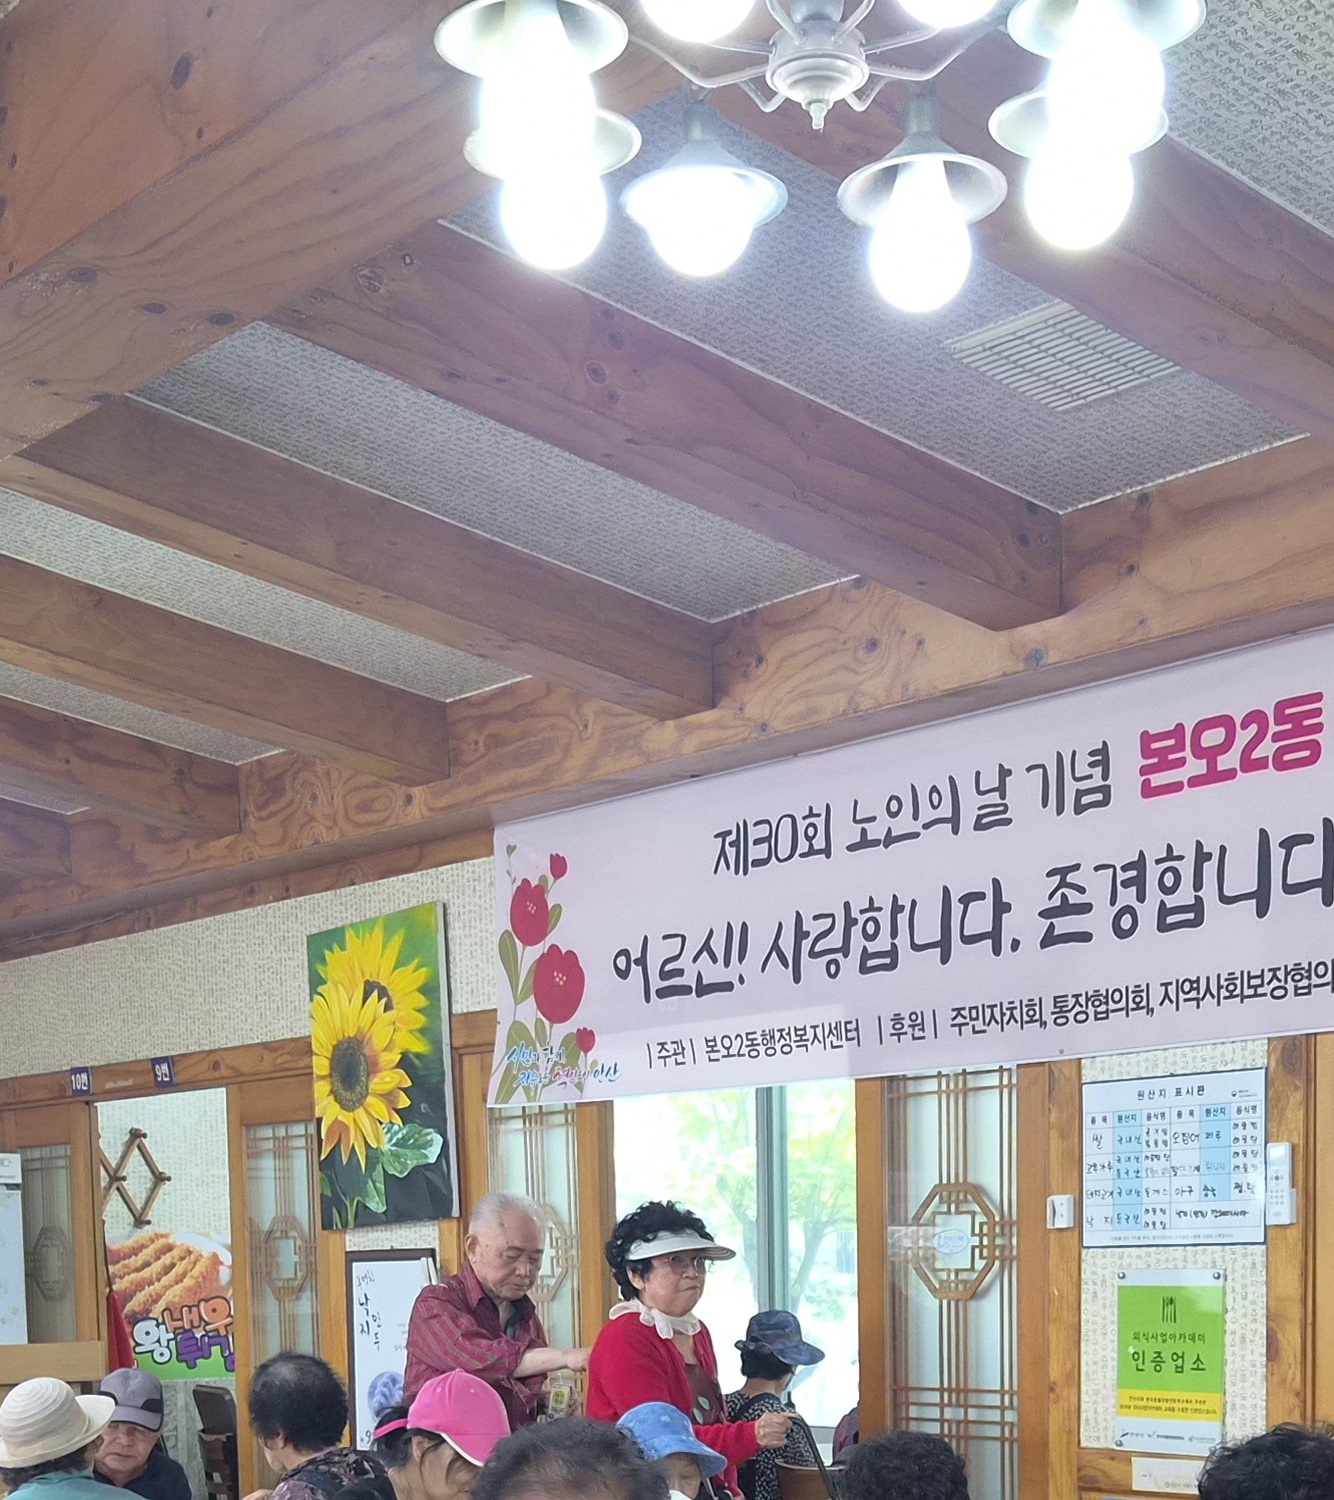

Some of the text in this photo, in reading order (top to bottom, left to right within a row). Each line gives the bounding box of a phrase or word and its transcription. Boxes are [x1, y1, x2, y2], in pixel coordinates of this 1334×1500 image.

[713, 803, 832, 876] 제30회
[846, 775, 961, 854] 노인의
[973, 762, 1013, 831] 날
[1026, 740, 1113, 816] 기념
[1139, 690, 1324, 799] 본오2동
[612, 921, 749, 1004] 어르신!
[761, 878, 1020, 985] 사랑합니다.
[704, 1018, 861, 1062] 본오2동행정복지센터
[950, 996, 1047, 1037] 주민자치회,
[1051, 982, 1155, 1027] 통장협의회,
[71, 1072, 88, 1090] 10번
[155, 1062, 170, 1081] 9번
[593, 1062, 620, 1083] 안산
[1137, 1085, 1206, 1101] 원산지 표시판
[133, 1317, 175, 1365] 왕
[1132, 1331, 1206, 1344] 외식사업아카데미
[1131, 1350, 1206, 1374] 인증업소
